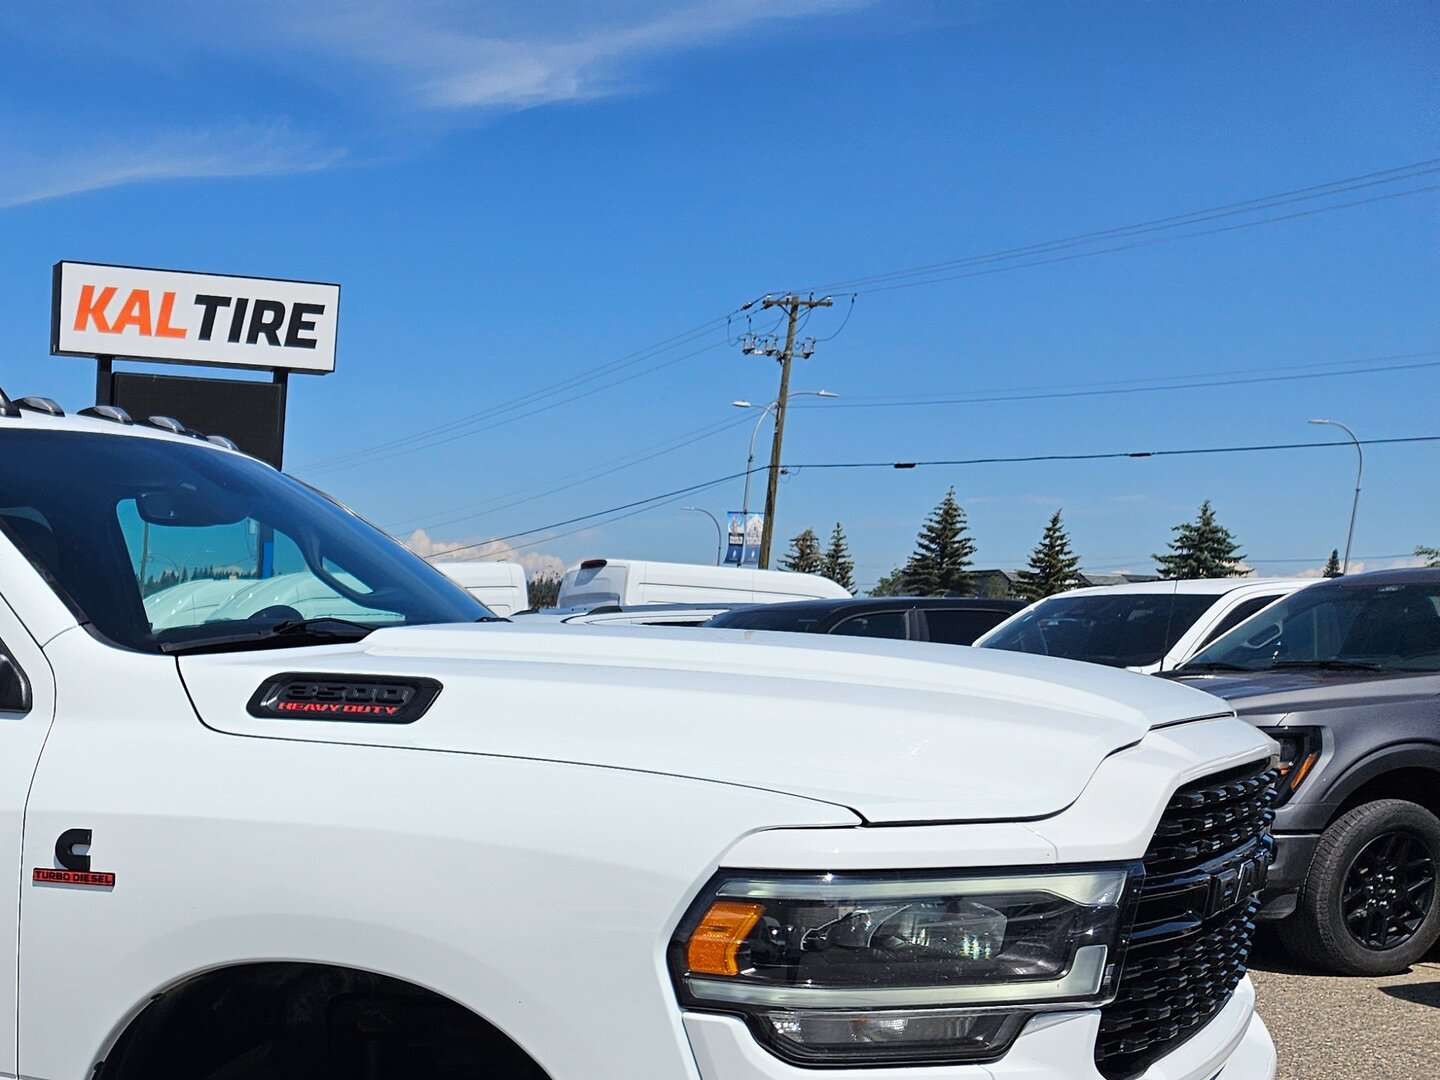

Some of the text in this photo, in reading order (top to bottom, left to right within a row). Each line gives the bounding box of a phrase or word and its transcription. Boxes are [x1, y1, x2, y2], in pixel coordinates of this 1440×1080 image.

[73, 285, 326, 349] KAL TIRE
[278, 702, 400, 715] HEAVY DUTY
[35, 871, 112, 884] TURBO DIESEL
